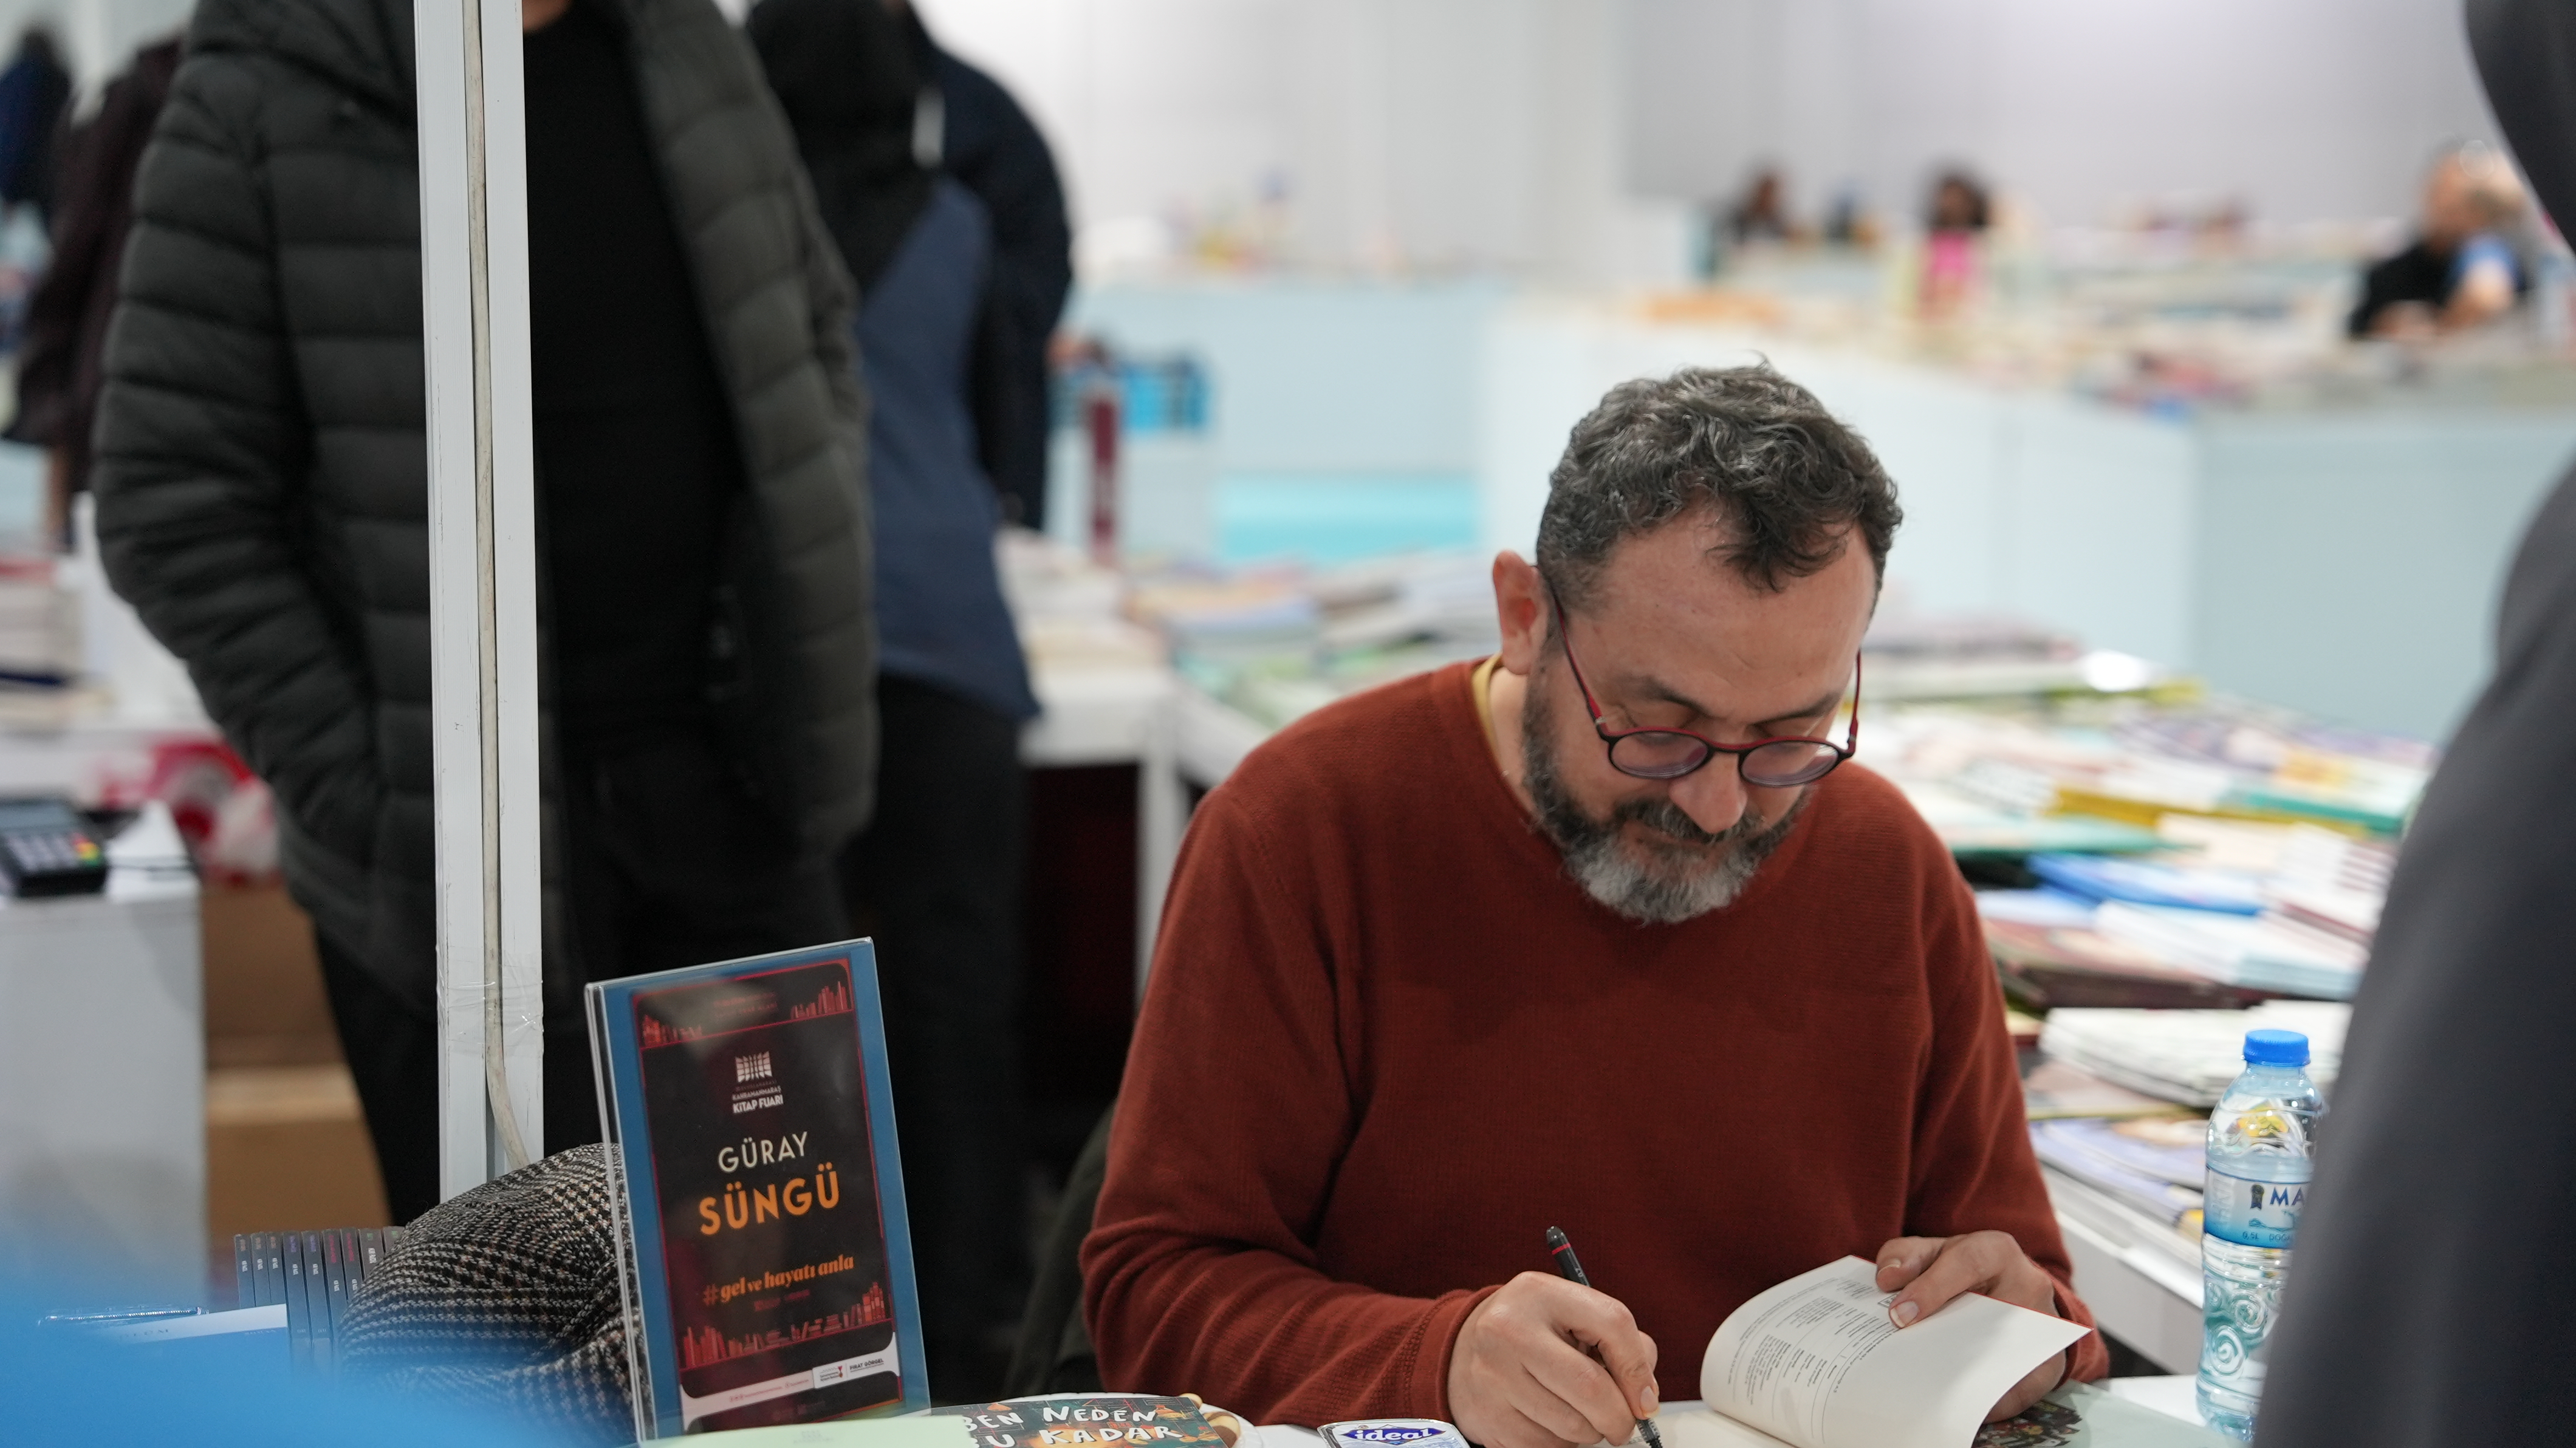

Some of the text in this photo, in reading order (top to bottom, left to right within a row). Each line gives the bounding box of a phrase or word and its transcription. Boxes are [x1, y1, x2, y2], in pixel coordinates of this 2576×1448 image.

[733, 1094, 784, 1113] KİTAP FUARI
[718, 1131, 807, 1173] GÜRAY
[699, 1162, 840, 1235] SÜNGÜ
[703, 1276, 746, 1306] #gel
[747, 1279, 762, 1291] ve
[764, 1263, 816, 1288] hayatı
[818, 1254, 854, 1276] anla
[1043, 1406, 1156, 1422] NEDEN
[1039, 1426, 1184, 1444] KADAR
[1354, 1429, 1433, 1441] ideal
